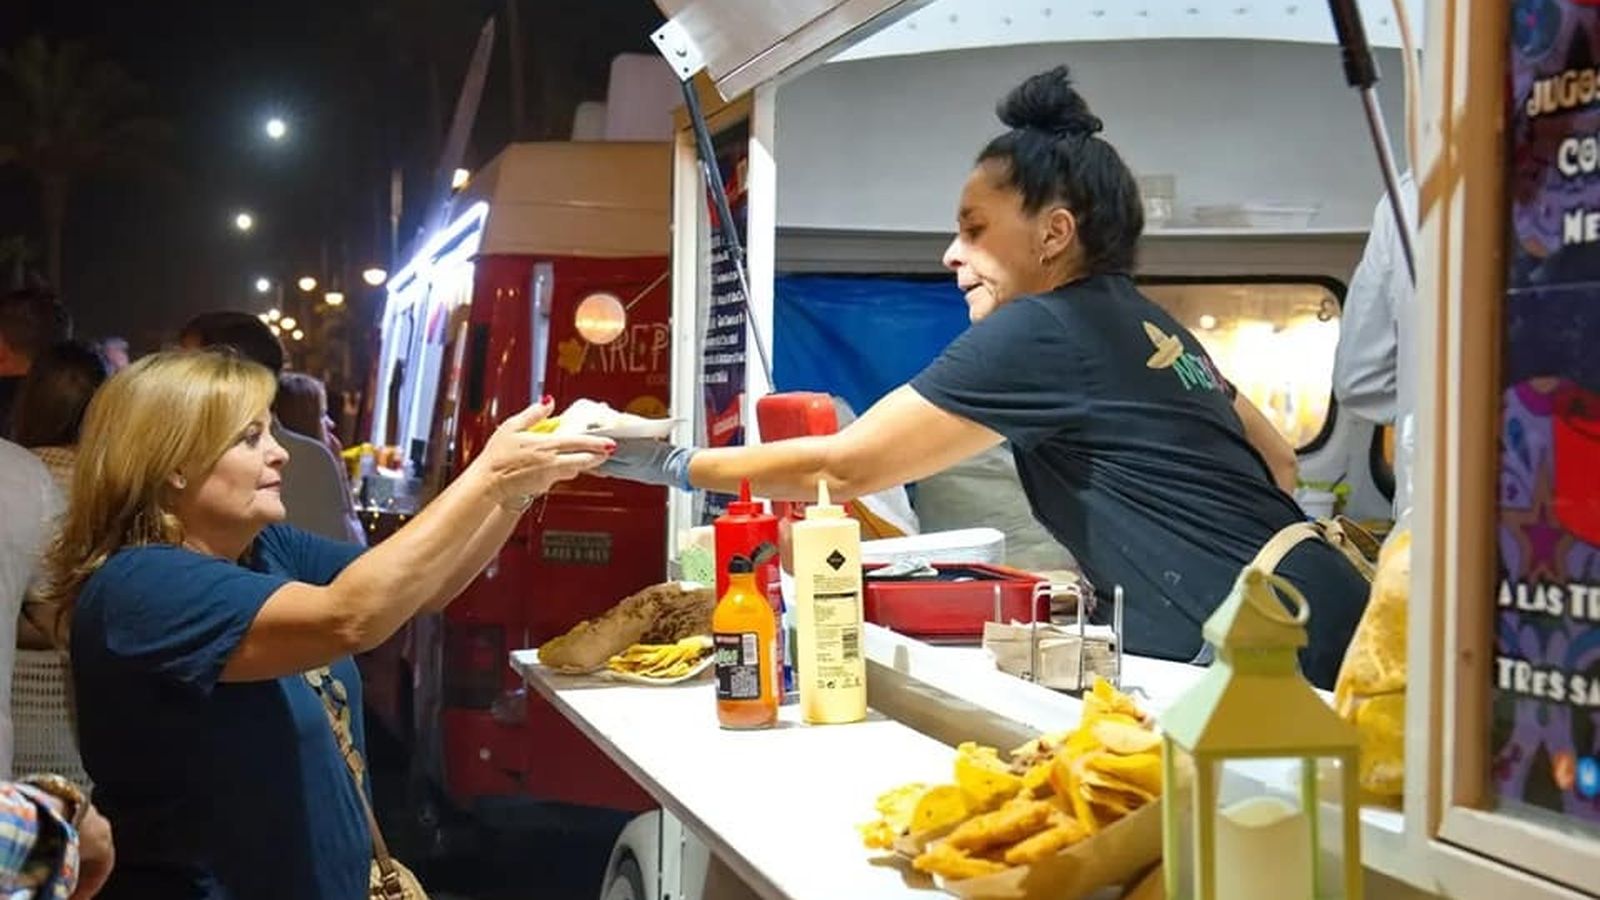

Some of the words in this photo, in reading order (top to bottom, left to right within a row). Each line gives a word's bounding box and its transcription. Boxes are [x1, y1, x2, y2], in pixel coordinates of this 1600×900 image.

[1558, 137, 1600, 176] CO
[1516, 582, 1564, 618] LAS
[1496, 657, 1566, 702] TRES
